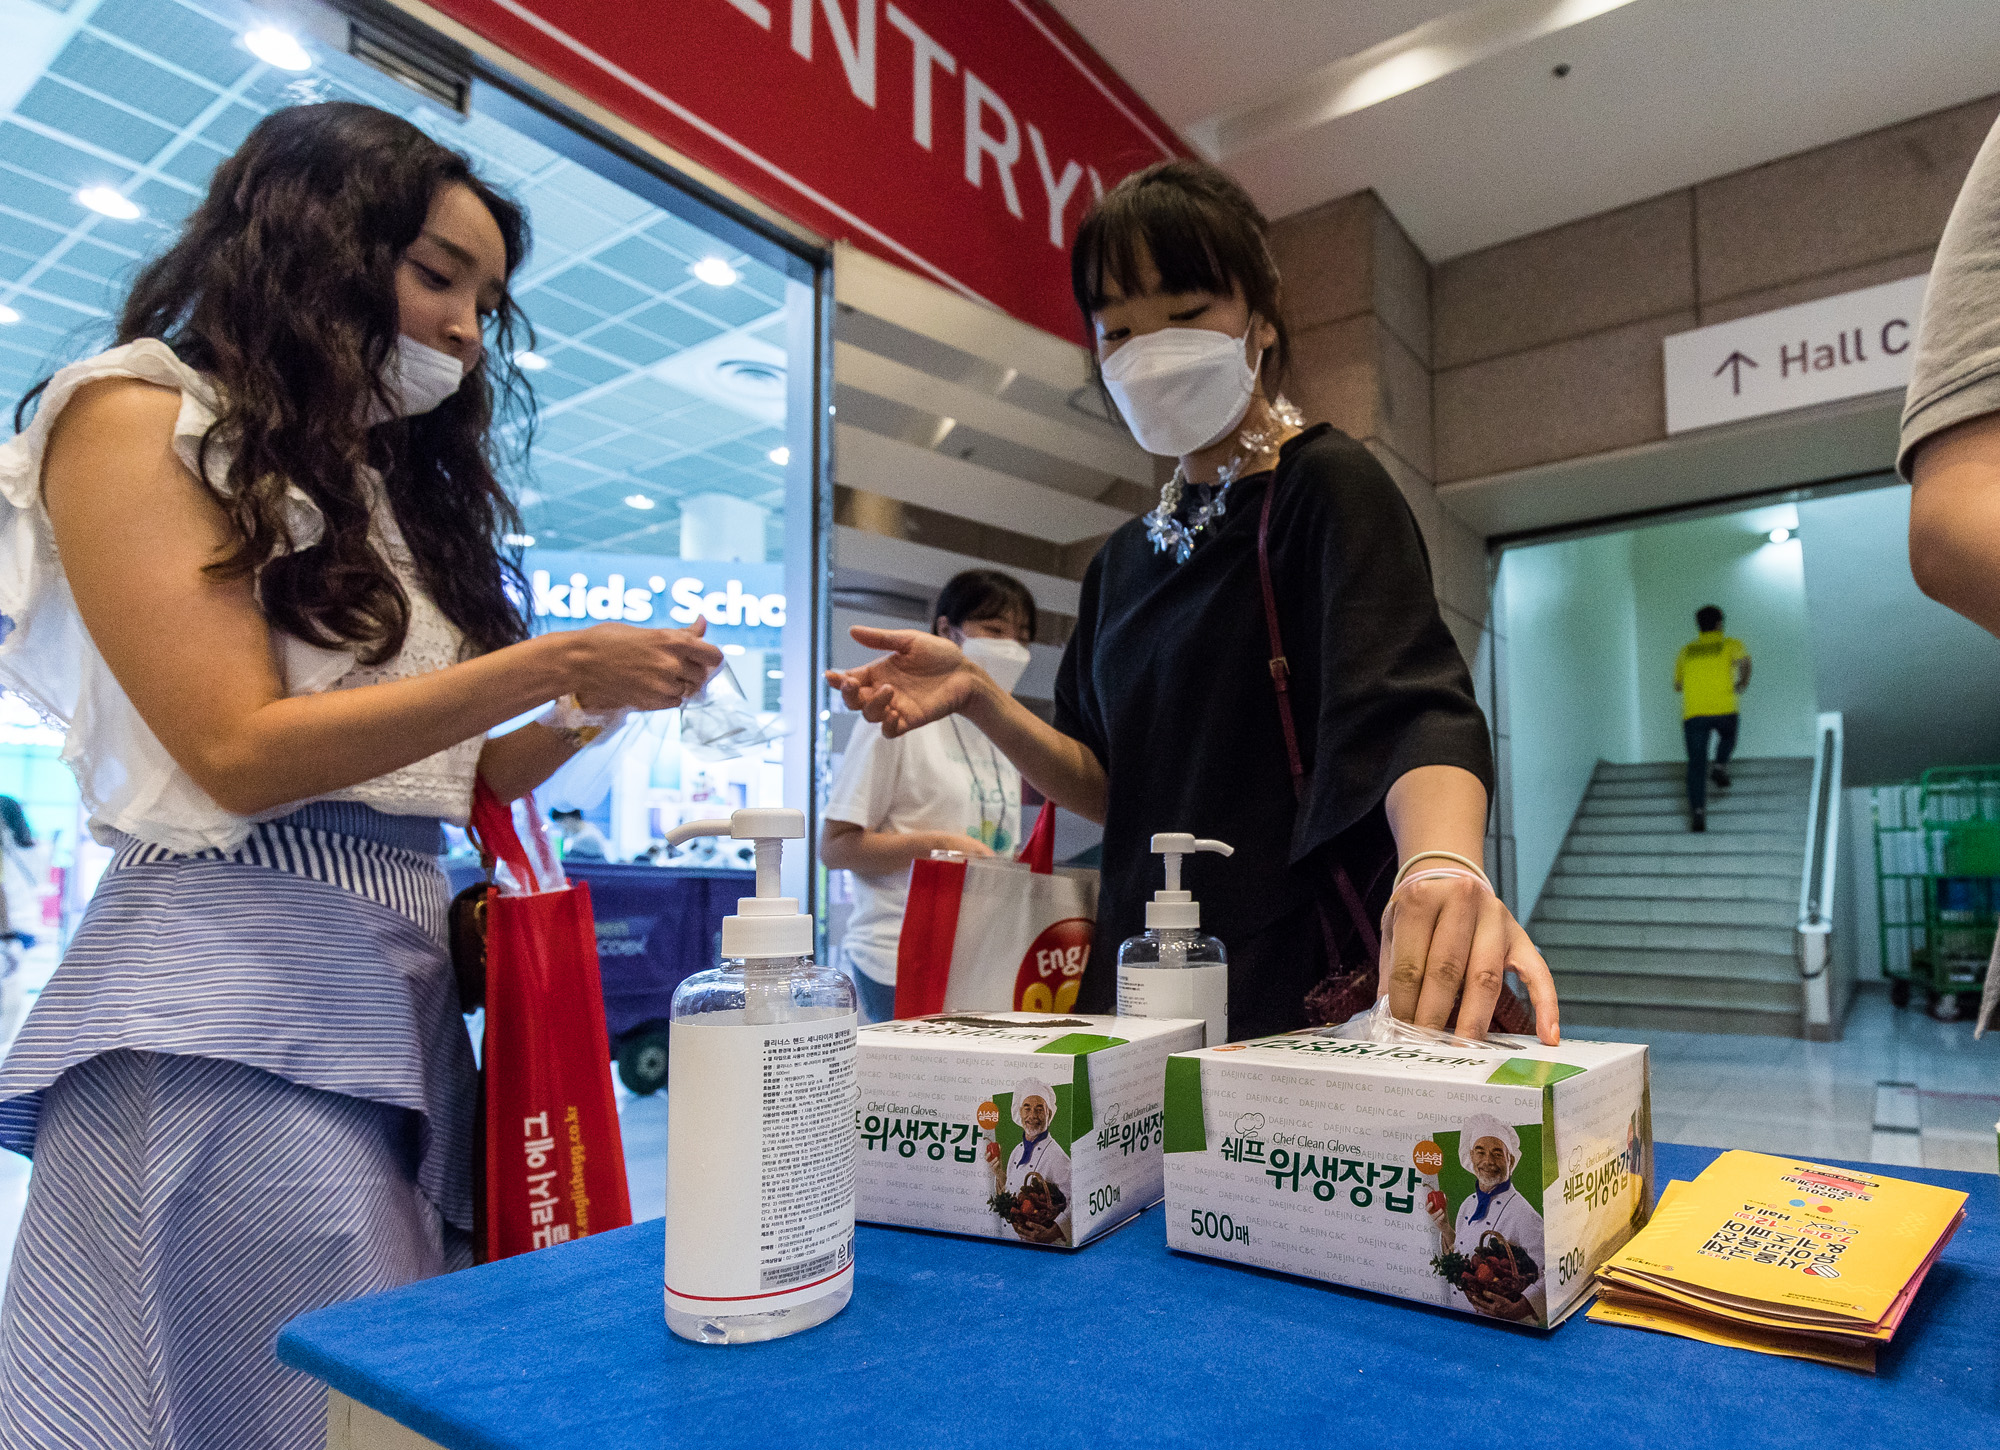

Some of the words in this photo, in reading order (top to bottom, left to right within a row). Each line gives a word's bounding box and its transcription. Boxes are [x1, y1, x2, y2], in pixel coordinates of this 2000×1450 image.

[724, 0, 1103, 249] NTRY
[1779, 326, 1868, 379] Hall
[1881, 318, 1911, 356] C
[532, 569, 666, 622] kids'
[867, 1101, 886, 1113] Chef
[887, 1103, 909, 1114] Clean
[911, 1104, 938, 1117] Gloves
[977, 1110, 1000, 1122] 실속형
[861, 1115, 983, 1164] 위생장갑
[1097, 1124, 1121, 1151] 쉐프
[1272, 1132, 1296, 1146] Chef
[1297, 1135, 1325, 1149] Clean
[1327, 1140, 1361, 1155] Gloves
[1414, 1150, 1443, 1167] 실속형
[1220, 1136, 1266, 1165] 쉐프
[1265, 1149, 1423, 1214] 위생장갑
[1563, 1171, 1585, 1205] 쉐프
[1798, 1186, 1845, 1202] 2020년
[1190, 1208, 1250, 1247] 500매
[1757, 1208, 1791, 1221] Hall
[1804, 1221, 1860, 1235] coex
[1711, 1229, 1841, 1265] 유아교육전
[1722, 1219, 1820, 1251] 키즈페어
[1826, 1242, 1848, 1254] &
[1702, 1239, 1806, 1270] 서울국제
